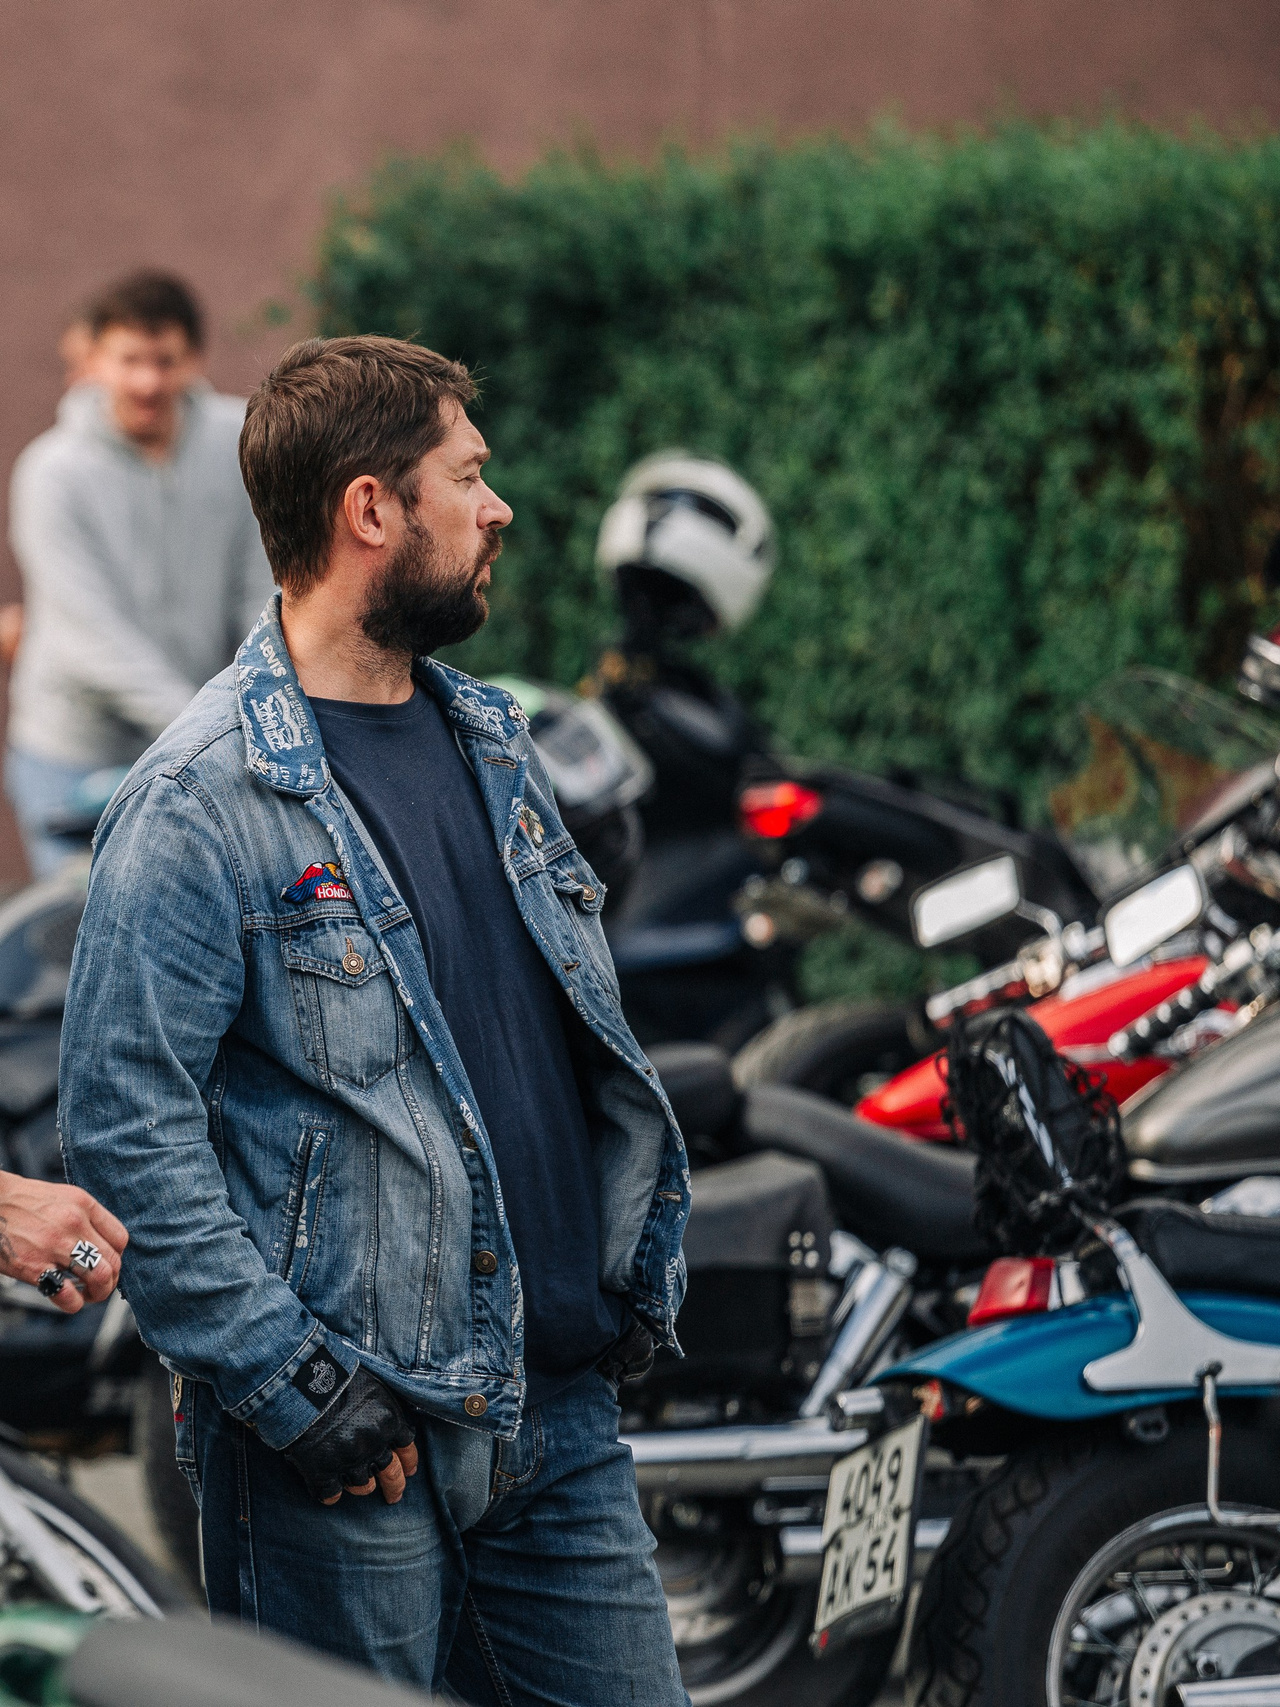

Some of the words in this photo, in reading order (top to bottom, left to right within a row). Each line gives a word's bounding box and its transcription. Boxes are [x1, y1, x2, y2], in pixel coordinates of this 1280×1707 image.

[293, 699, 309, 728] STRAUSS
[317, 888, 353, 899] HONDA
[840, 1448, 903, 1522] 4049
[863, 1532, 897, 1592] 54
